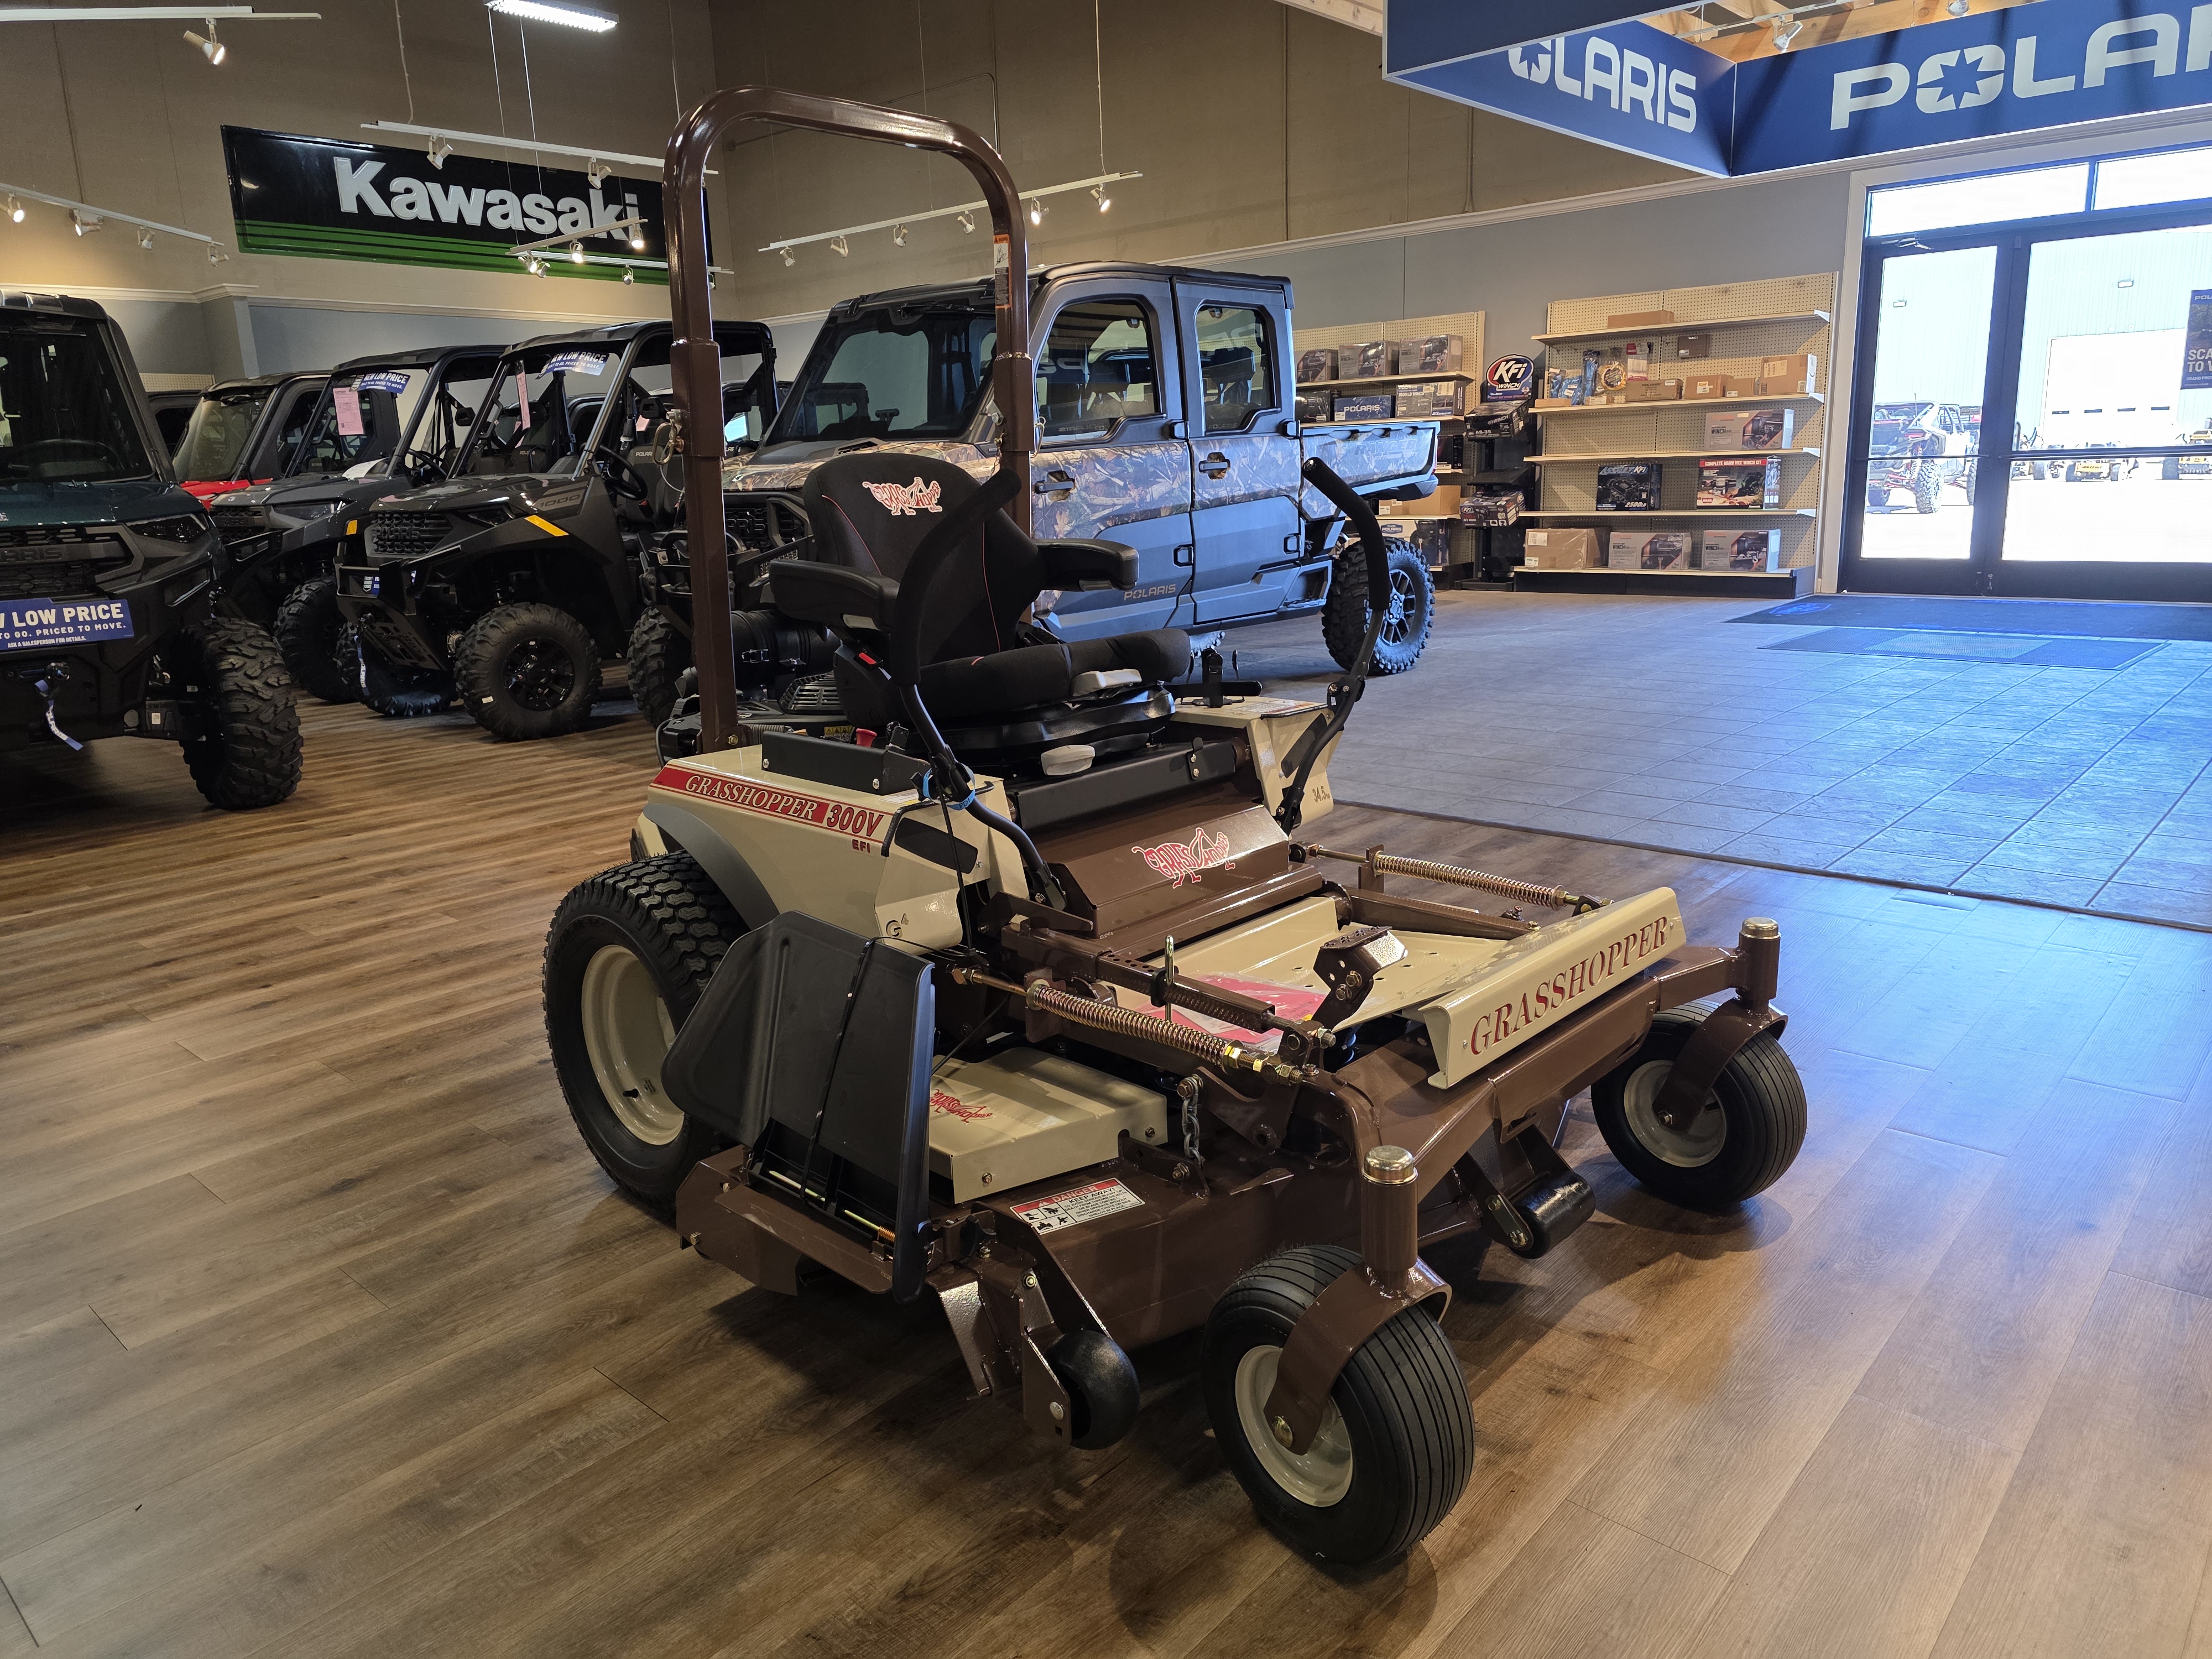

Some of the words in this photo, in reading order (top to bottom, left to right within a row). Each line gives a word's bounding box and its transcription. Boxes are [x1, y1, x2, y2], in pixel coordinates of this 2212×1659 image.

[333, 156, 639, 241] Kawasaki
[563, 351, 580, 360] LOW
[578, 352, 607, 364] PRICE
[2187, 361, 2204, 373] TO
[386, 373, 408, 384] PRICE
[1354, 439, 1418, 455] RANGER
[540, 494, 580, 508] 1000
[1124, 584, 1176, 601] POLARIS
[12, 608, 56, 627] LOW
[63, 603, 124, 623] PRICE
[36, 625, 74, 637] PRICED
[95, 622, 126, 630] MOVE.
[685, 775, 817, 820] GRASSHOPPER
[826, 804, 884, 837] 300V
[959, 798, 970, 808] PDI
[852, 839, 870, 853] EFI
[1470, 916, 1668, 1056] GRASSHOPPER
[1052, 1186, 1099, 1202] DANGER
[1068, 1195, 1088, 1203] KEEP
[1092, 1187, 1116, 1197] AWAY!
